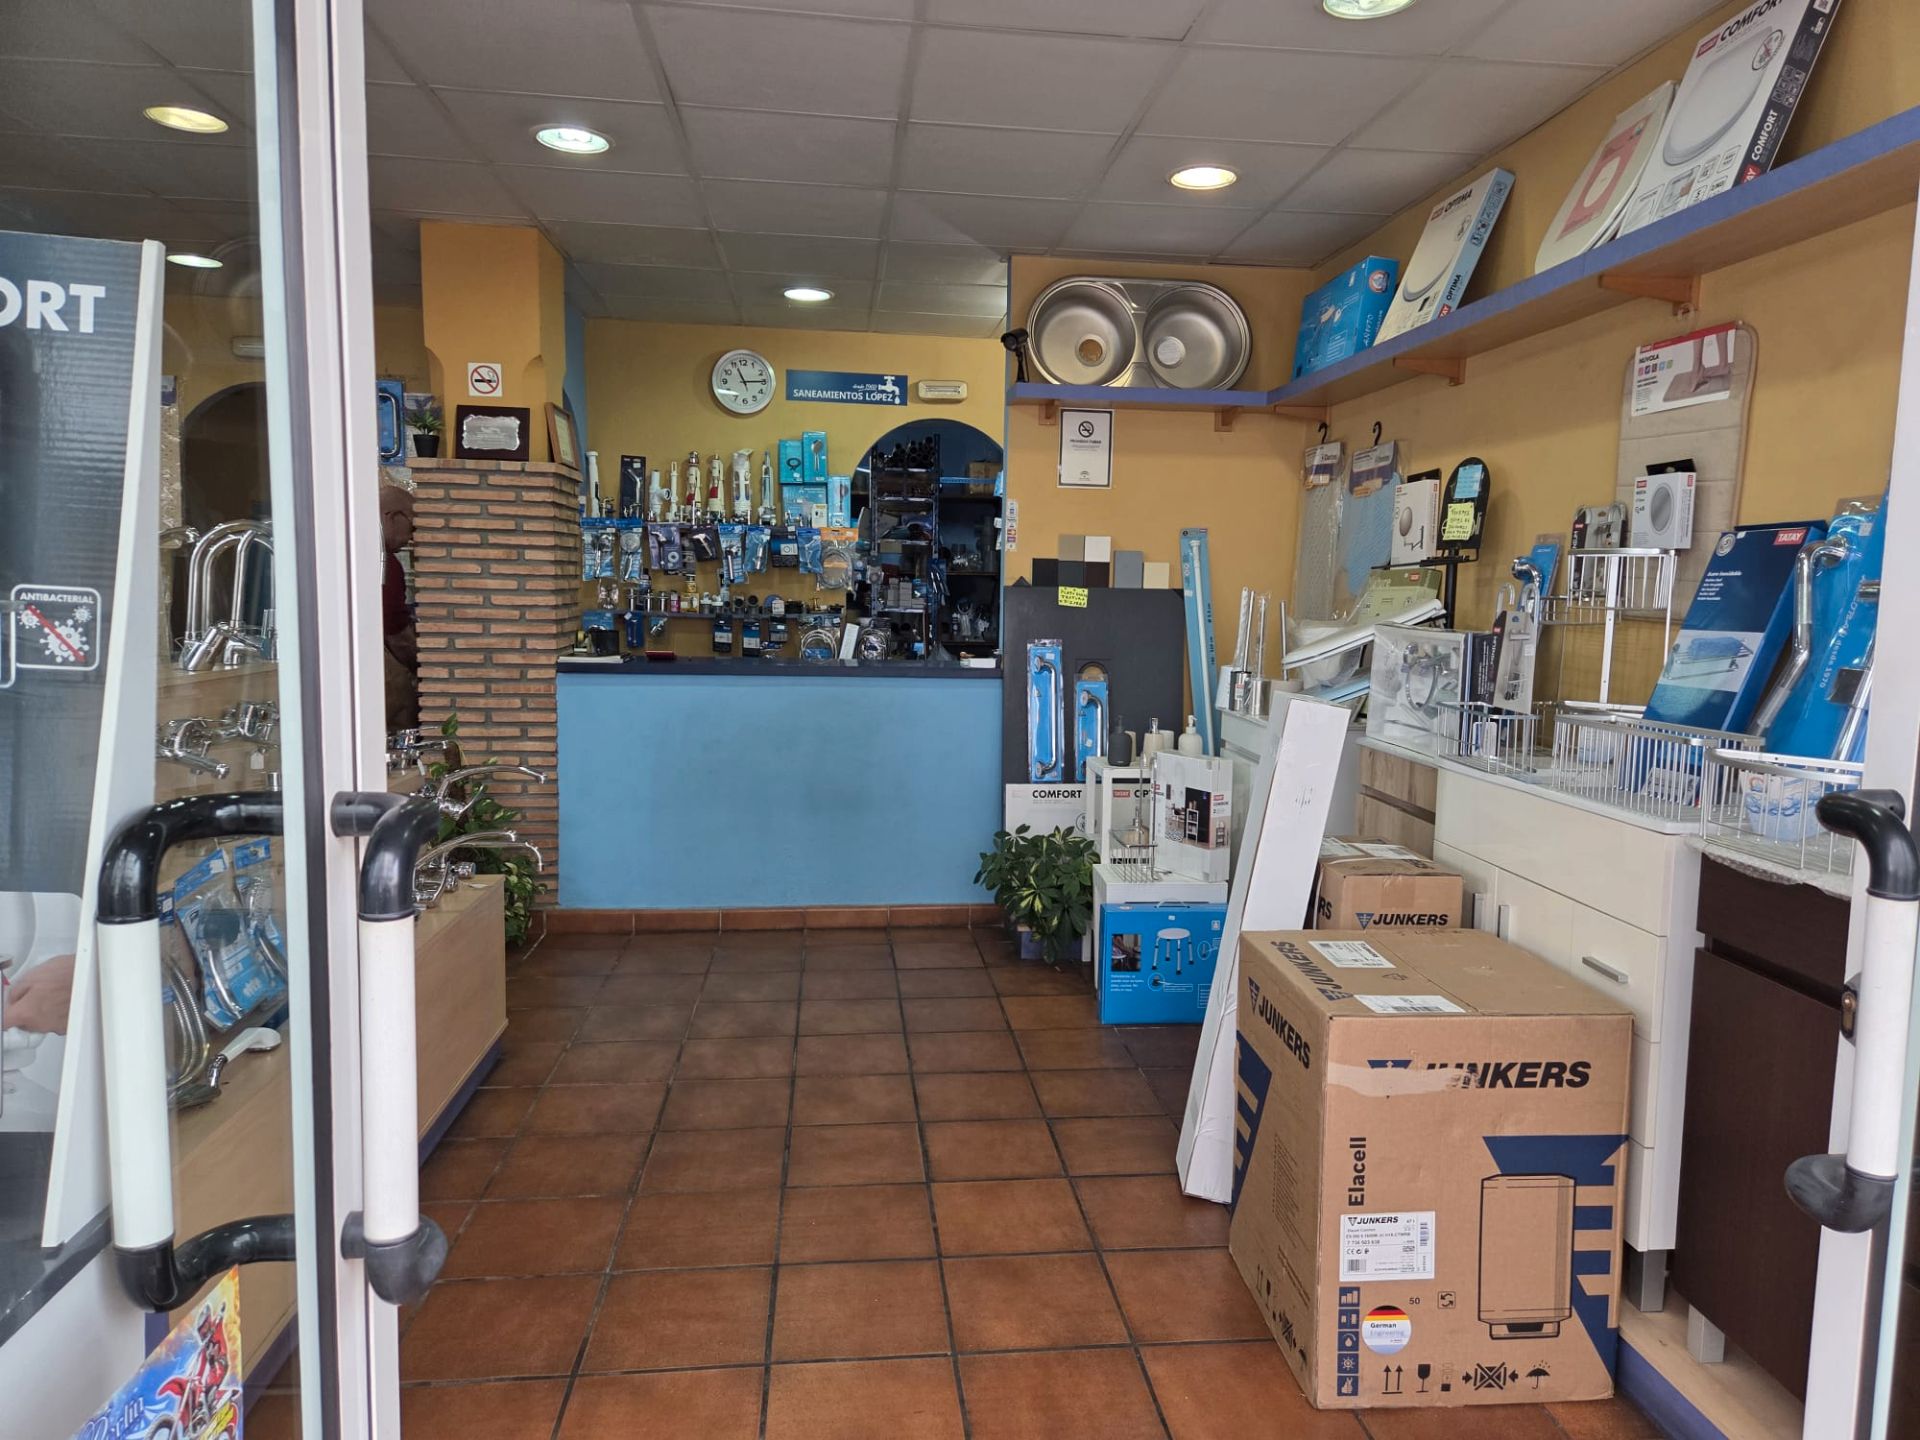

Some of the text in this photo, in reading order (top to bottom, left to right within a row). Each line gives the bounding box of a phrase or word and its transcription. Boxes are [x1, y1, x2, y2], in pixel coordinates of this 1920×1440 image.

[1751, 109, 1778, 161] COMFORT
[1445, 273, 1462, 301] OPTIMA
[793, 388, 893, 402] SANEAMIENTOS LÓPEZ
[1777, 532, 1804, 541] TATAY
[20, 592, 94, 604] ANTIBACTERIAL
[1032, 789, 1082, 799] COMFORT
[1373, 913, 1448, 926] JUNKERS
[1270, 940, 1343, 990] JUNKERS
[1258, 996, 1311, 1070] JUNKERS
[1427, 1061, 1591, 1089] NKERS
[1348, 1137, 1366, 1206] Elacell
[1357, 1216, 1399, 1225] JUNKERS
[1409, 1297, 1421, 1305] 50
